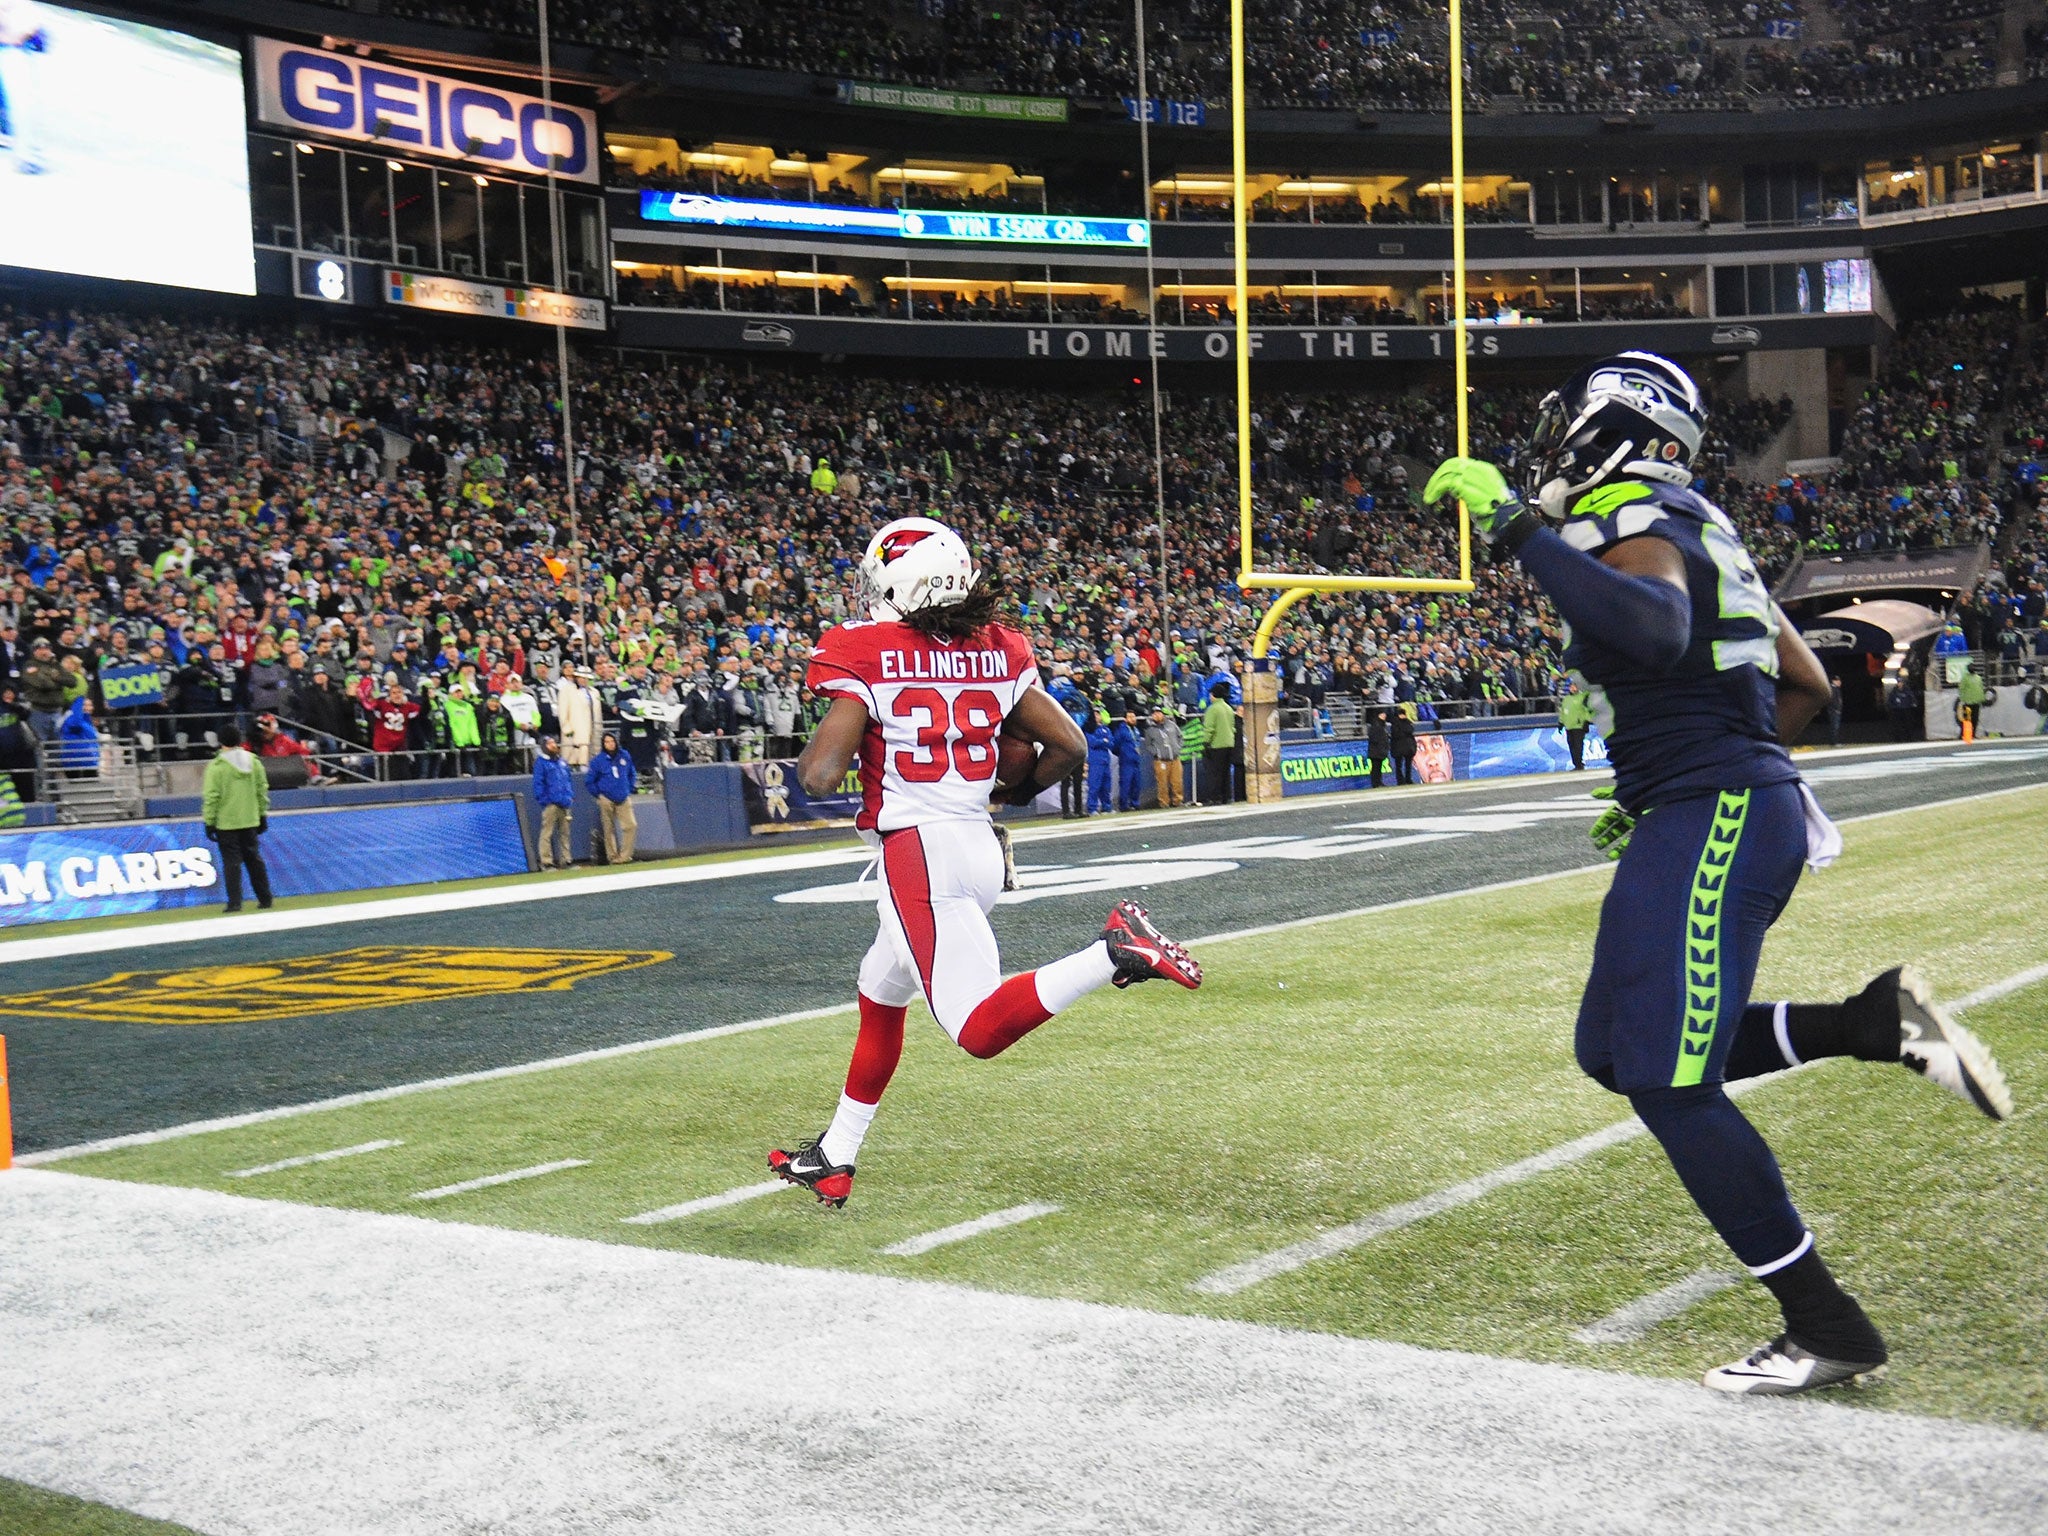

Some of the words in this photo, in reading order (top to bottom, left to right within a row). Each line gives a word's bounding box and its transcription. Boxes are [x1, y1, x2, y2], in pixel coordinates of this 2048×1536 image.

[279, 50, 587, 174] GEICO
[1175, 103, 1199, 125] 12
[946, 215, 991, 237] WIN
[317, 260, 345, 300] 8
[418, 281, 497, 310] Microsoft
[532, 299, 601, 323] Microsoft
[1027, 330, 1167, 357] HOME
[1204, 332, 1264, 358] OF
[1299, 332, 1391, 357] THE
[1428, 332, 1500, 356] 12s
[945, 575, 967, 590] 38
[880, 649, 1009, 679] ELLINGTON
[101, 672, 162, 700] BOOM
[891, 687, 1004, 783] 38
[0, 860, 52, 906] M
[60, 847, 217, 898] CARES
